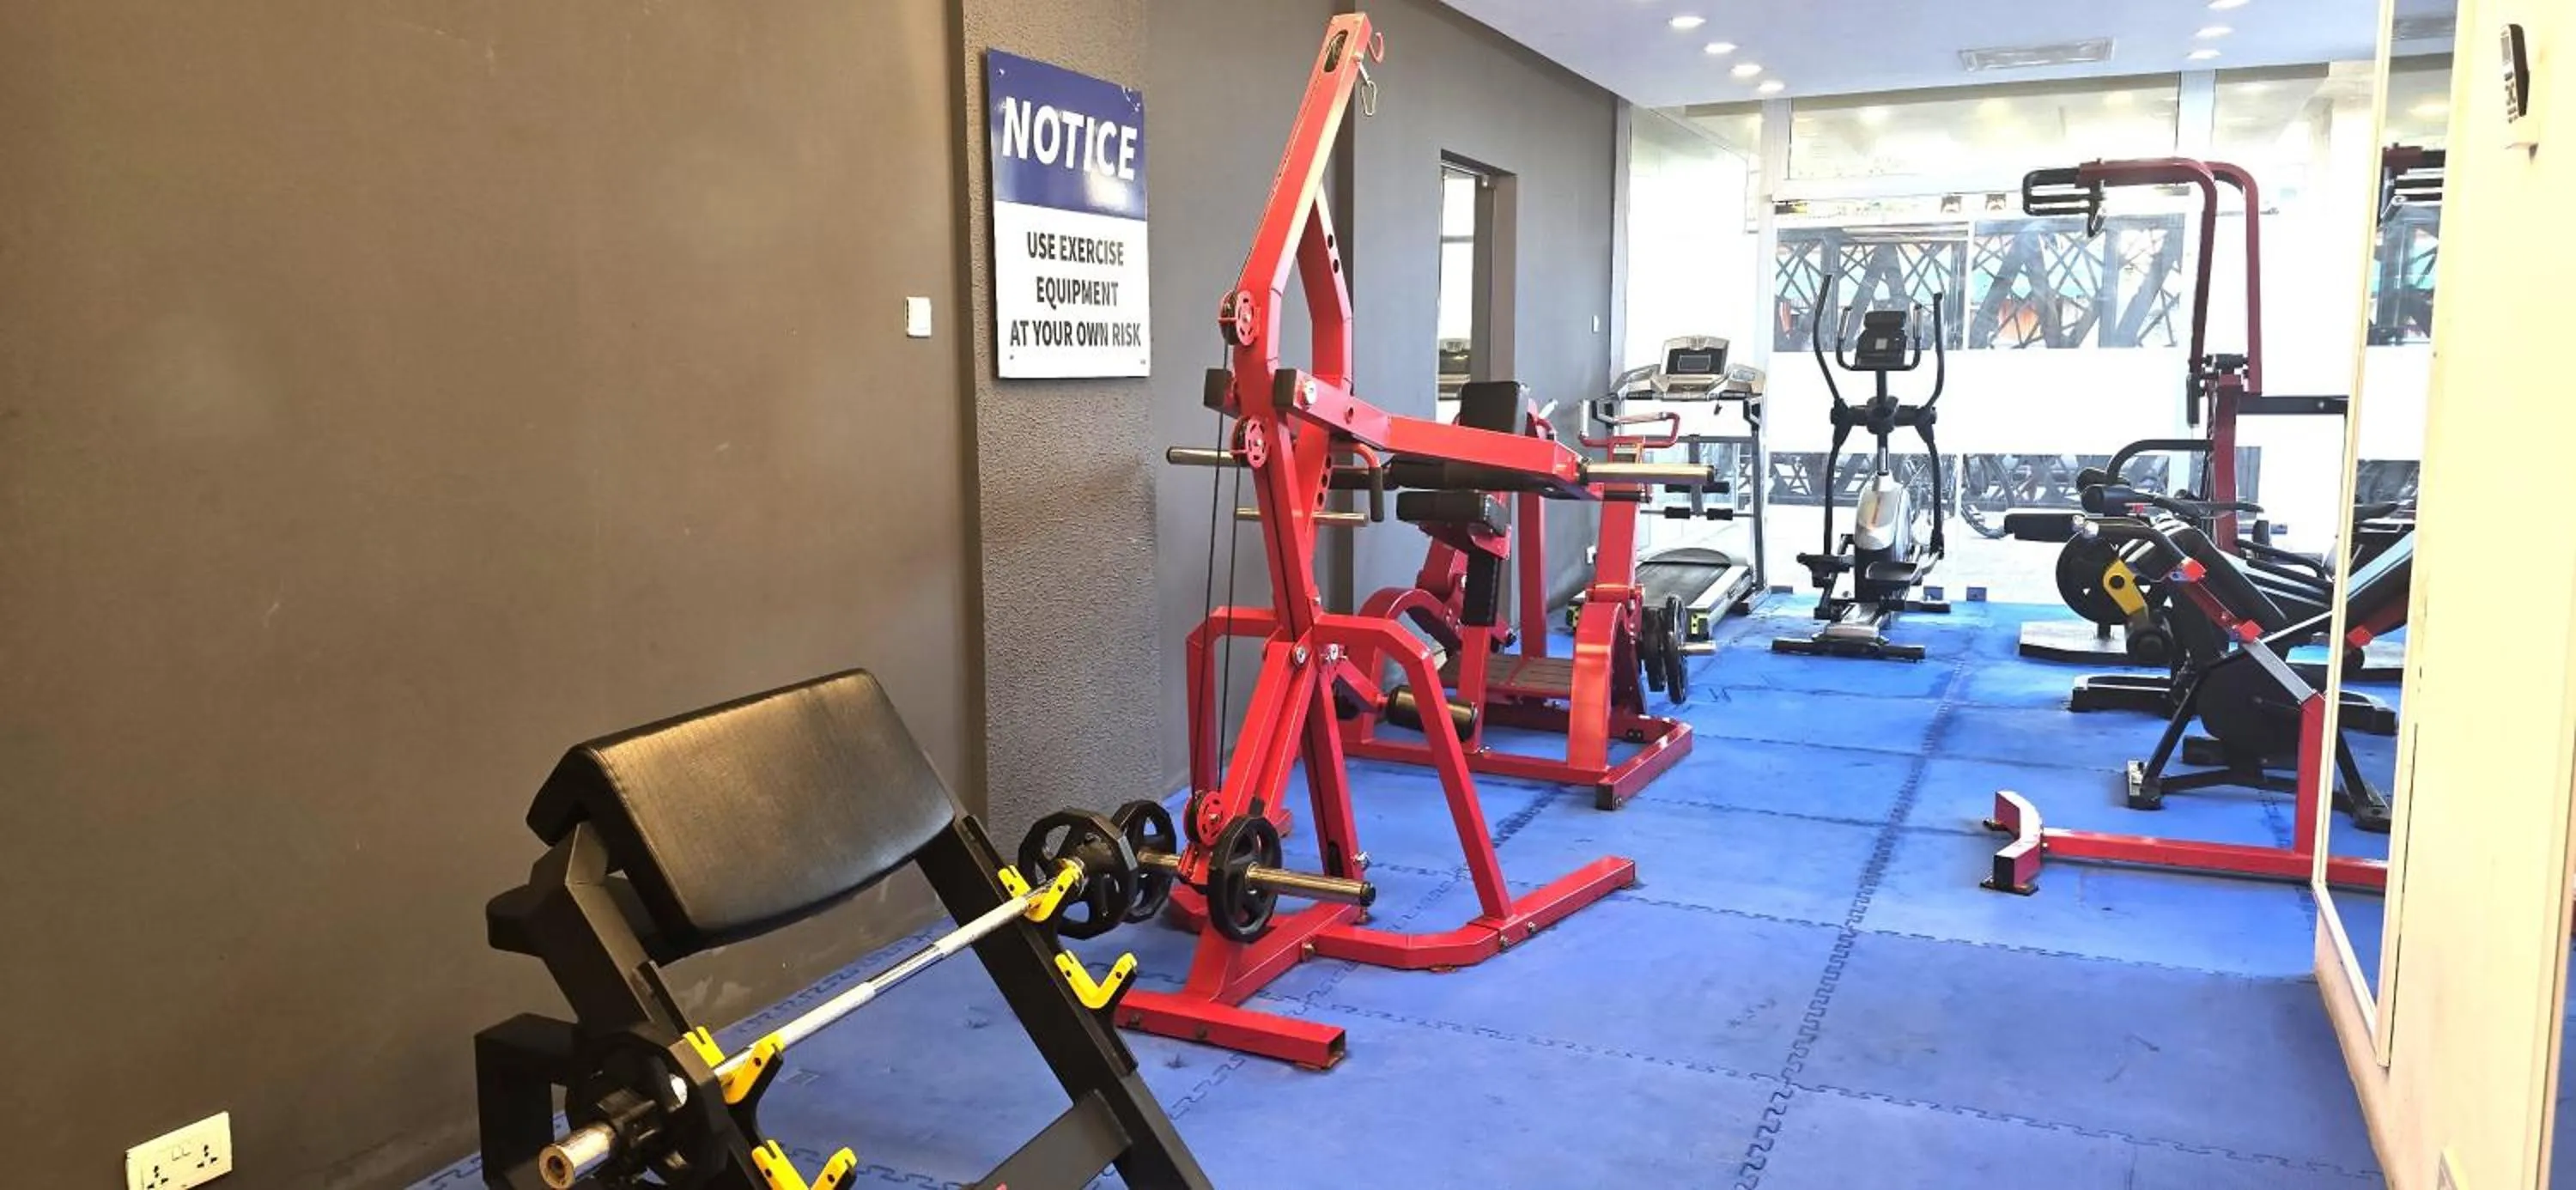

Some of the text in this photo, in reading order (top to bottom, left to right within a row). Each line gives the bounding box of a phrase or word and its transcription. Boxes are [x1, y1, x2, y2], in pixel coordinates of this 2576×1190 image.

[1002, 96, 1138, 180] NOTICE
[1027, 231, 1124, 266] USE EXERCISE
[1036, 276, 1118, 310] EQUIPMENT
[1010, 319, 1141, 347] AT YOUR OWN RISK
